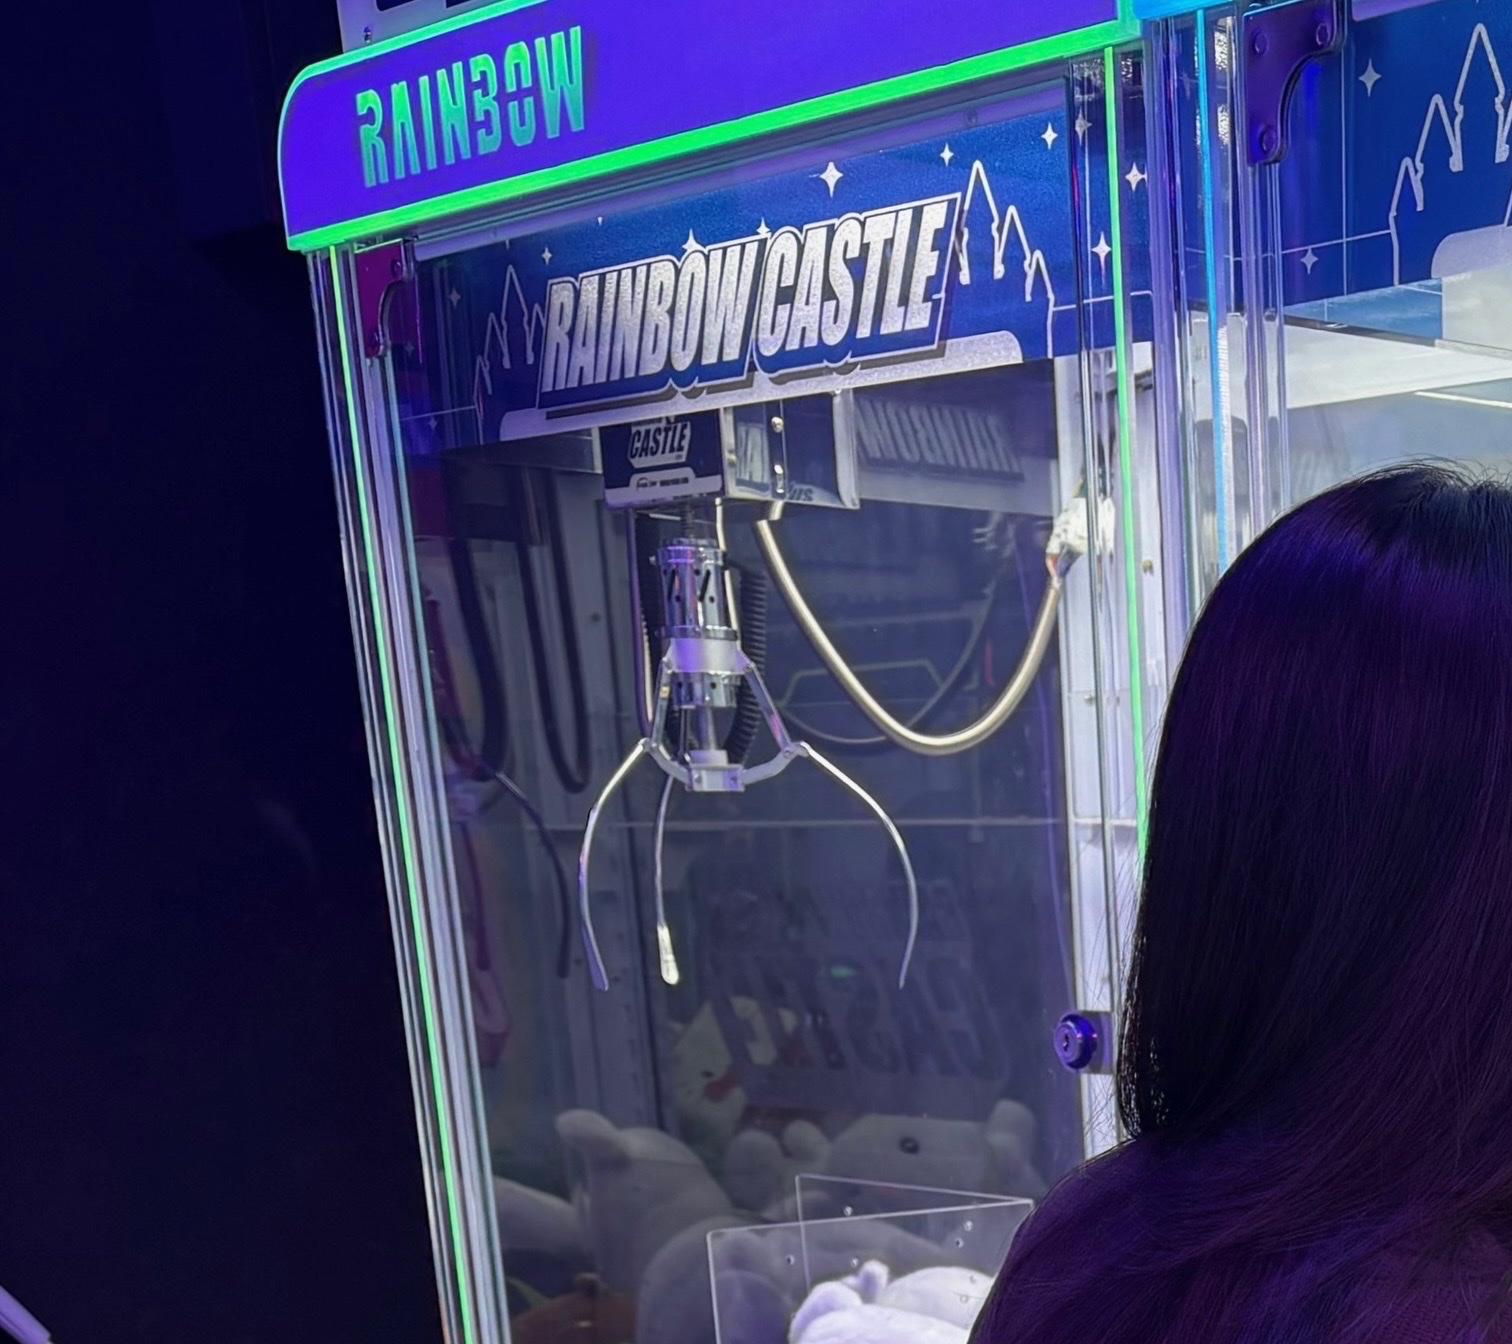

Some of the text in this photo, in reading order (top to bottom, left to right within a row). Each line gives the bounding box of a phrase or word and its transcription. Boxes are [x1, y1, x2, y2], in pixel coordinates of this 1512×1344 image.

[356, 26, 585, 188] RAINBOW
[539, 202, 947, 393] RAINBOW CASTLE
[630, 422, 688, 460] CASTLE
